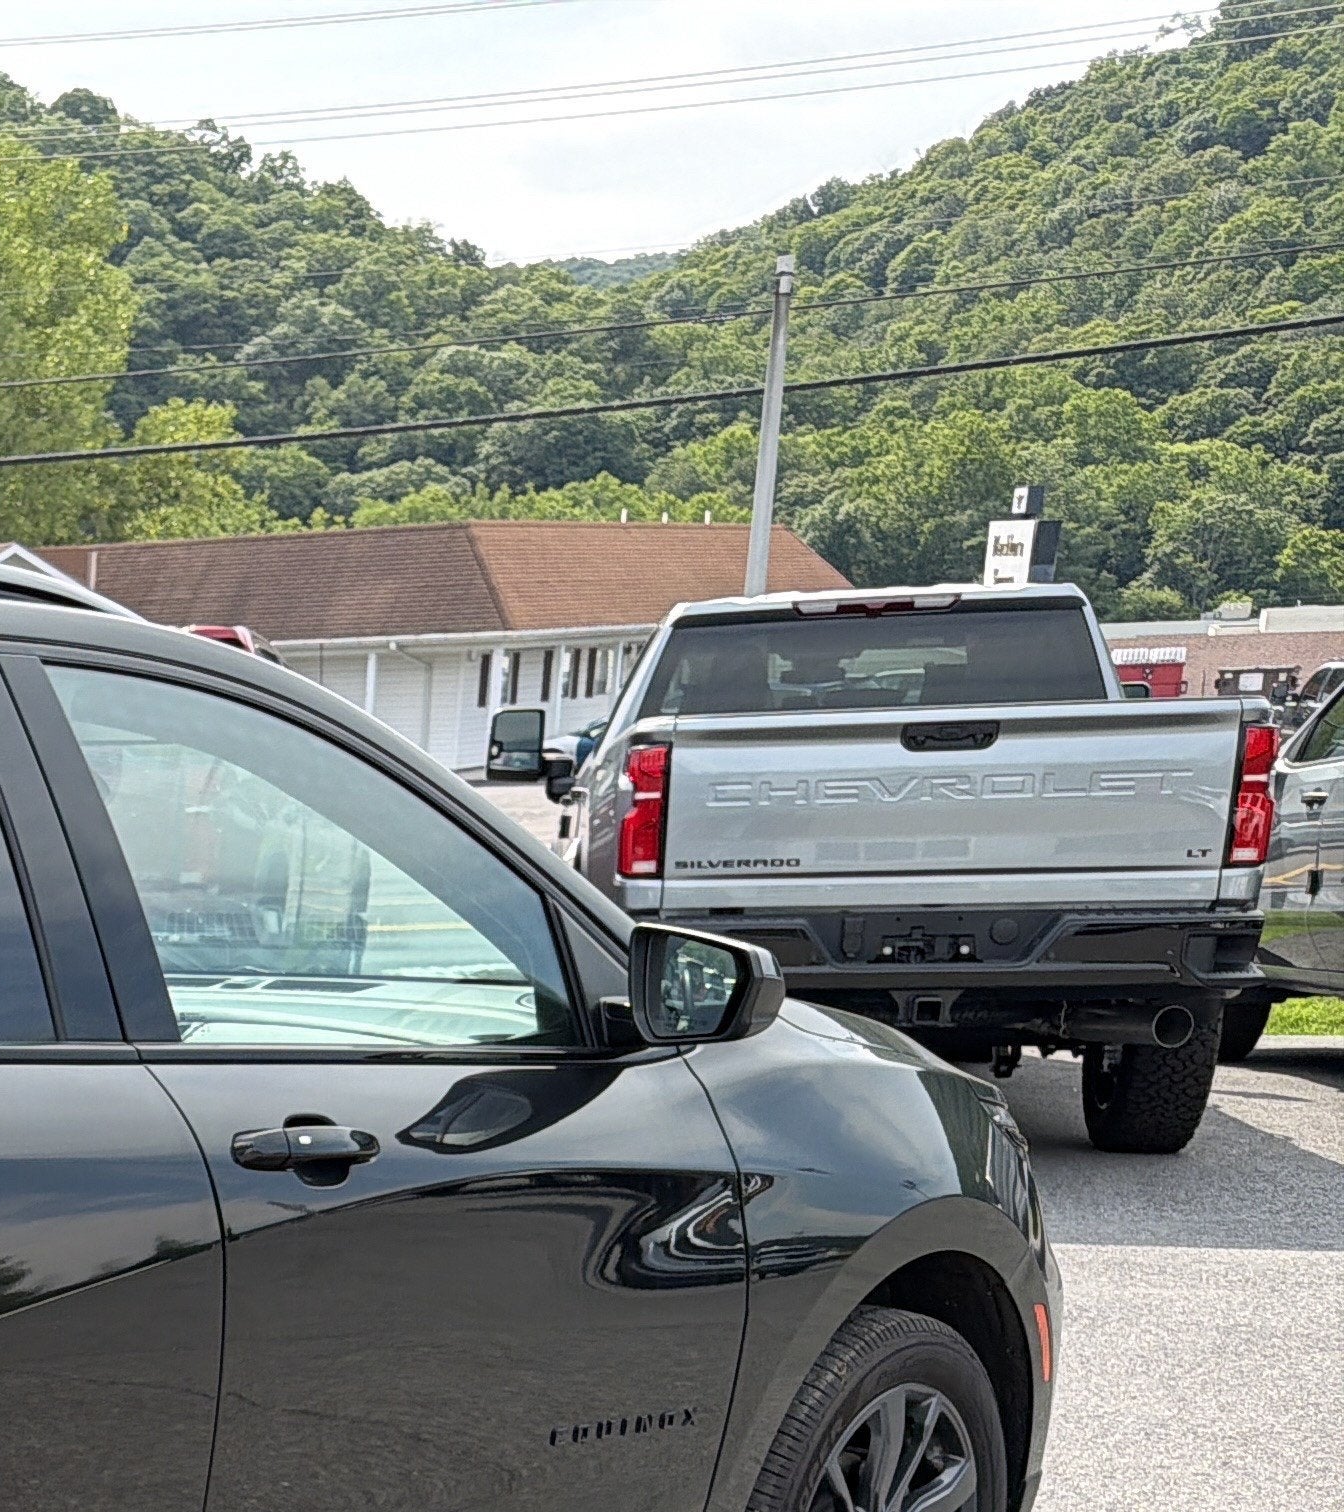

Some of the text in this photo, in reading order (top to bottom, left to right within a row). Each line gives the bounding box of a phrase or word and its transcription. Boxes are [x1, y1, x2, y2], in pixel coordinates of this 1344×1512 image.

[706, 769, 1194, 807] CHEVROLET
[1186, 848, 1212, 859] LT
[674, 857, 801, 869] SILVERADO
